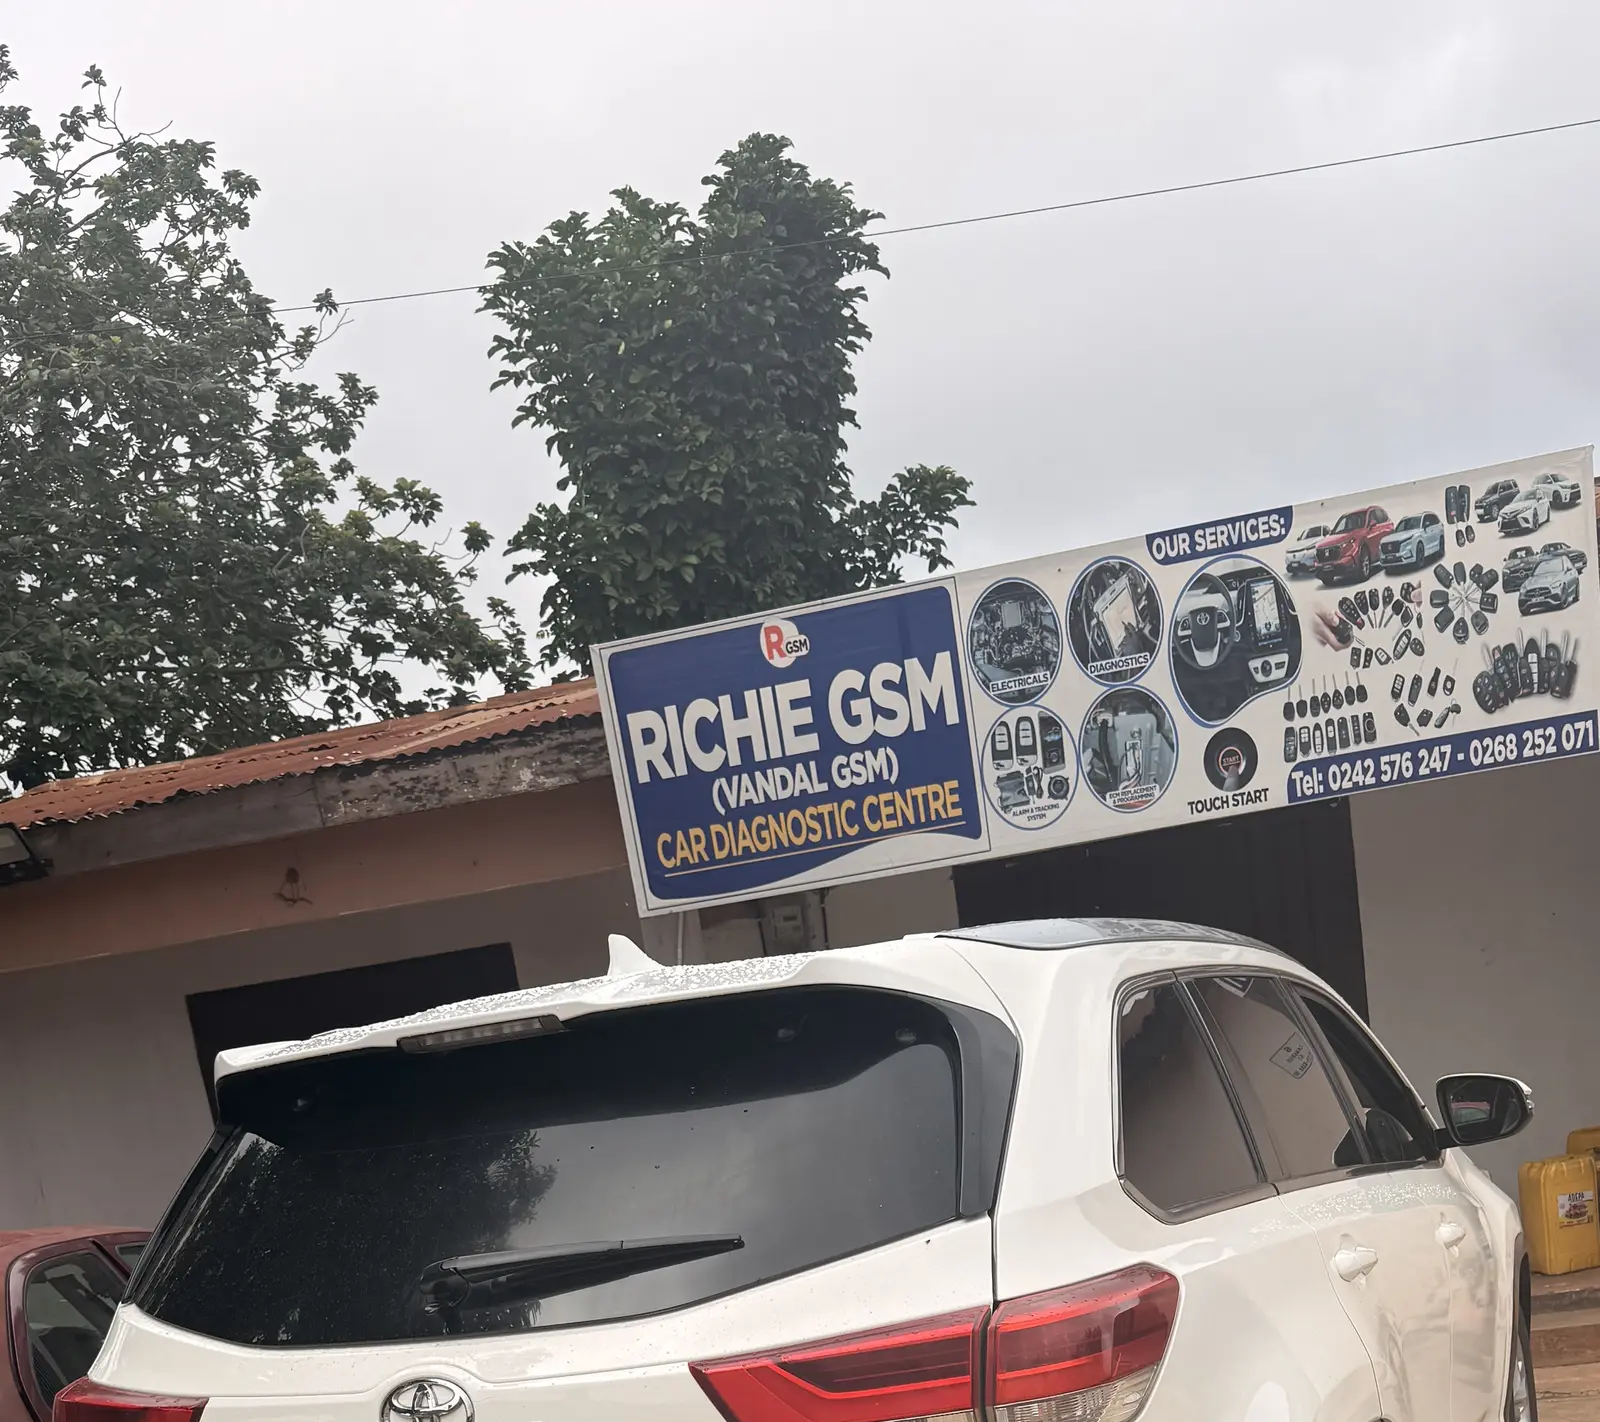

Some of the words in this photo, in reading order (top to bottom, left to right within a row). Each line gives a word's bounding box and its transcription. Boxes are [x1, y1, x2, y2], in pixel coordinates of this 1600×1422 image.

[1152, 532, 1191, 560] OUR
[1194, 514, 1286, 552] SERVICES:
[764, 625, 786, 660] R
[785, 638, 809, 655] GSM
[1089, 654, 1149, 675] DIAGNOSTICS
[991, 673, 1049, 693] ELECTRICALS
[626, 678, 820, 784] RICHIE
[828, 651, 960, 745] GSM
[1222, 755, 1240, 764] START
[1291, 768, 1324, 797] Tel:
[1327, 758, 1376, 791] 0242
[1380, 751, 1413, 782] 576
[1417, 744, 1452, 776] 247
[1469, 733, 1518, 766] 0268
[1522, 726, 1557, 760] 252
[1561, 720, 1595, 751] 071
[712, 761, 828, 816] (VANDAL
[831, 746, 899, 789] GSM)
[1120, 785, 1157, 798] REPLACEMENT
[1012, 807, 1030, 817] ALARM
[1034, 803, 1060, 814] TRACKING
[1187, 795, 1230, 815] TOUCH
[1232, 788, 1269, 807] START
[657, 833, 708, 869] CAR
[710, 801, 860, 860] DIAGNOSTIC
[862, 780, 963, 831] CENTRE
[1027, 813, 1047, 822] SYSTEM
